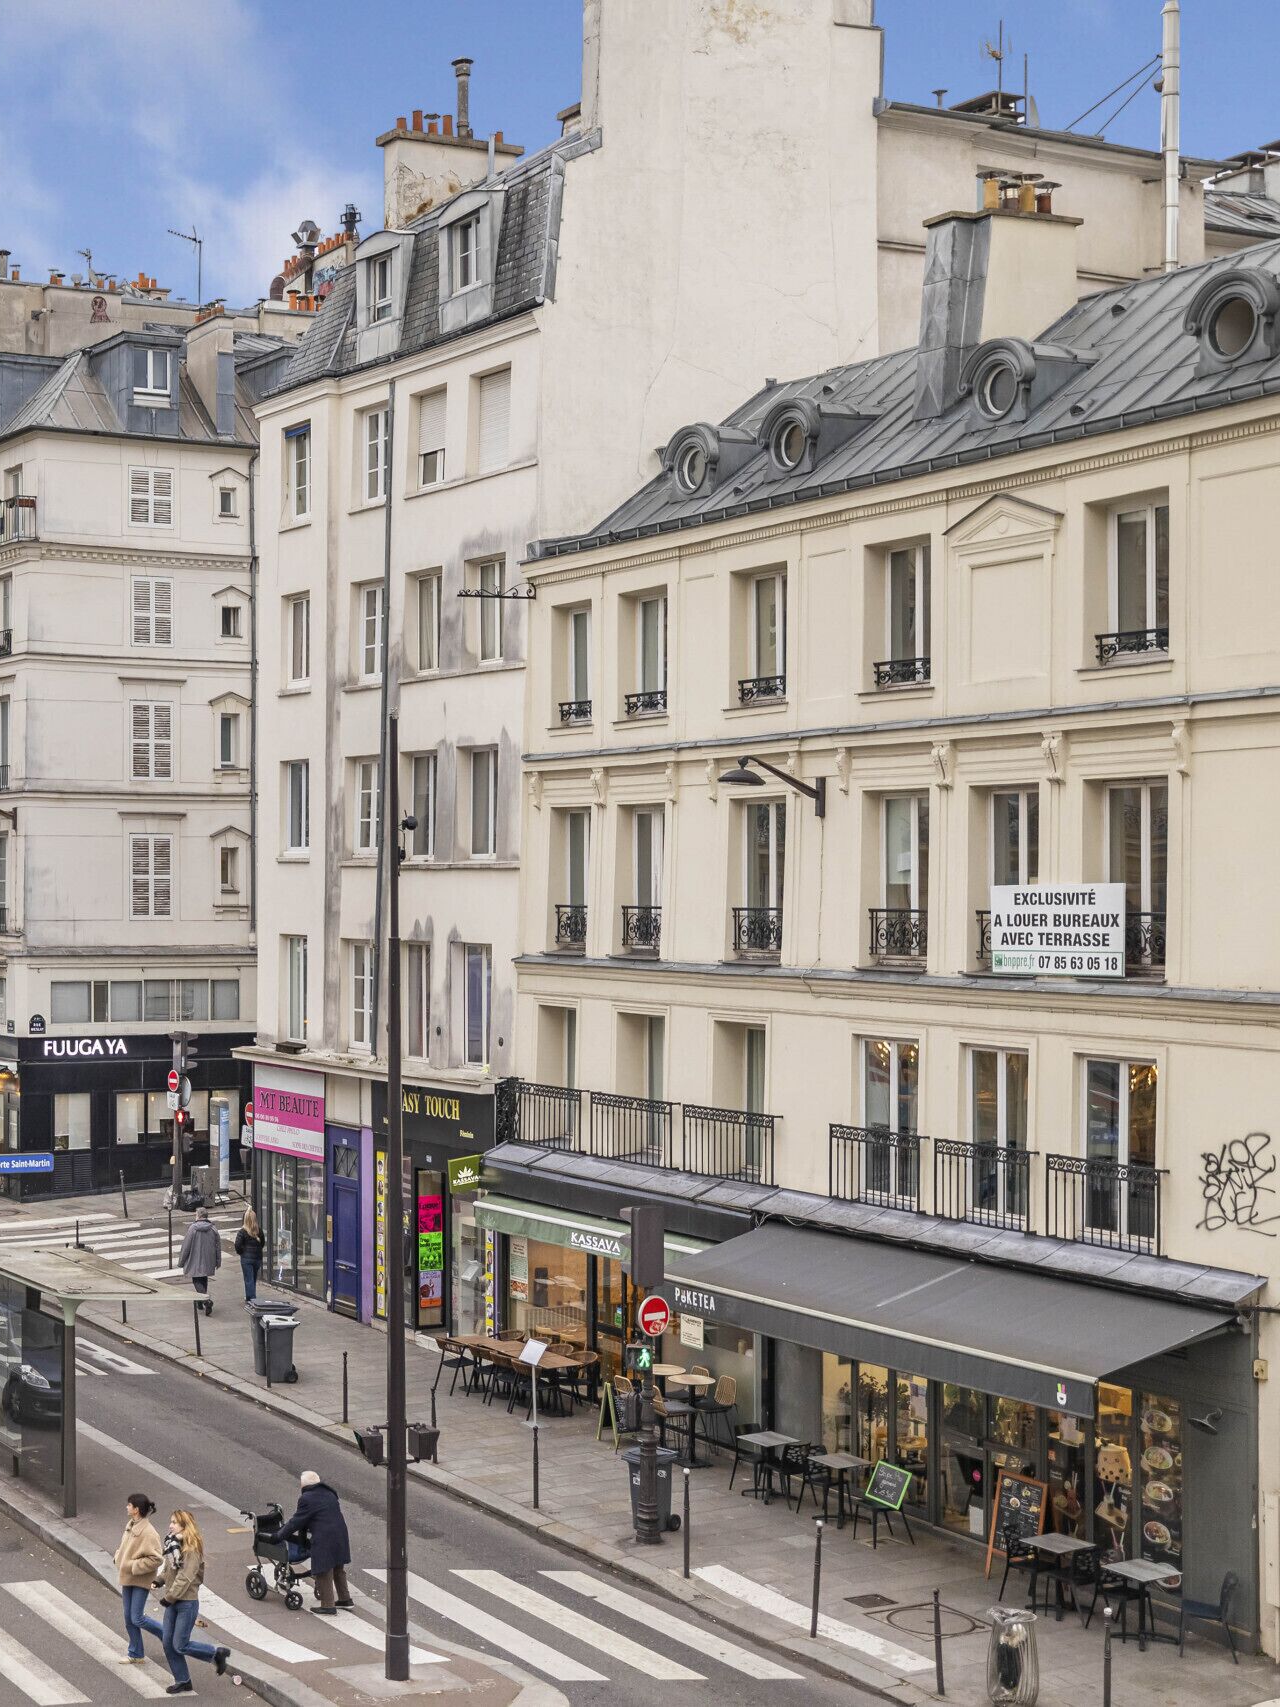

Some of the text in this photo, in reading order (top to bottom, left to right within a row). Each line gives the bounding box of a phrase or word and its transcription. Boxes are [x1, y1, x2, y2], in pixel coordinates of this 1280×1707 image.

[1013, 889, 1096, 906] EXCLUSIVITÉ
[994, 913, 1120, 928] A LOUER BUREAUX
[1001, 932, 1110, 947] AVEC TERRASSE
[1038, 955, 1051, 968] 07
[1054, 956, 1067, 969] 85
[1070, 956, 1083, 970] 63
[1087, 957, 1100, 970] 05
[1104, 957, 1118, 970] 18
[260, 1091, 276, 1110] MT
[279, 1096, 319, 1118] BEAUTE
[402, 1089, 460, 1120] ASY TOUCH
[11, 1158, 51, 1169] Saint-Martin
[570, 1232, 621, 1253] KASSAVA
